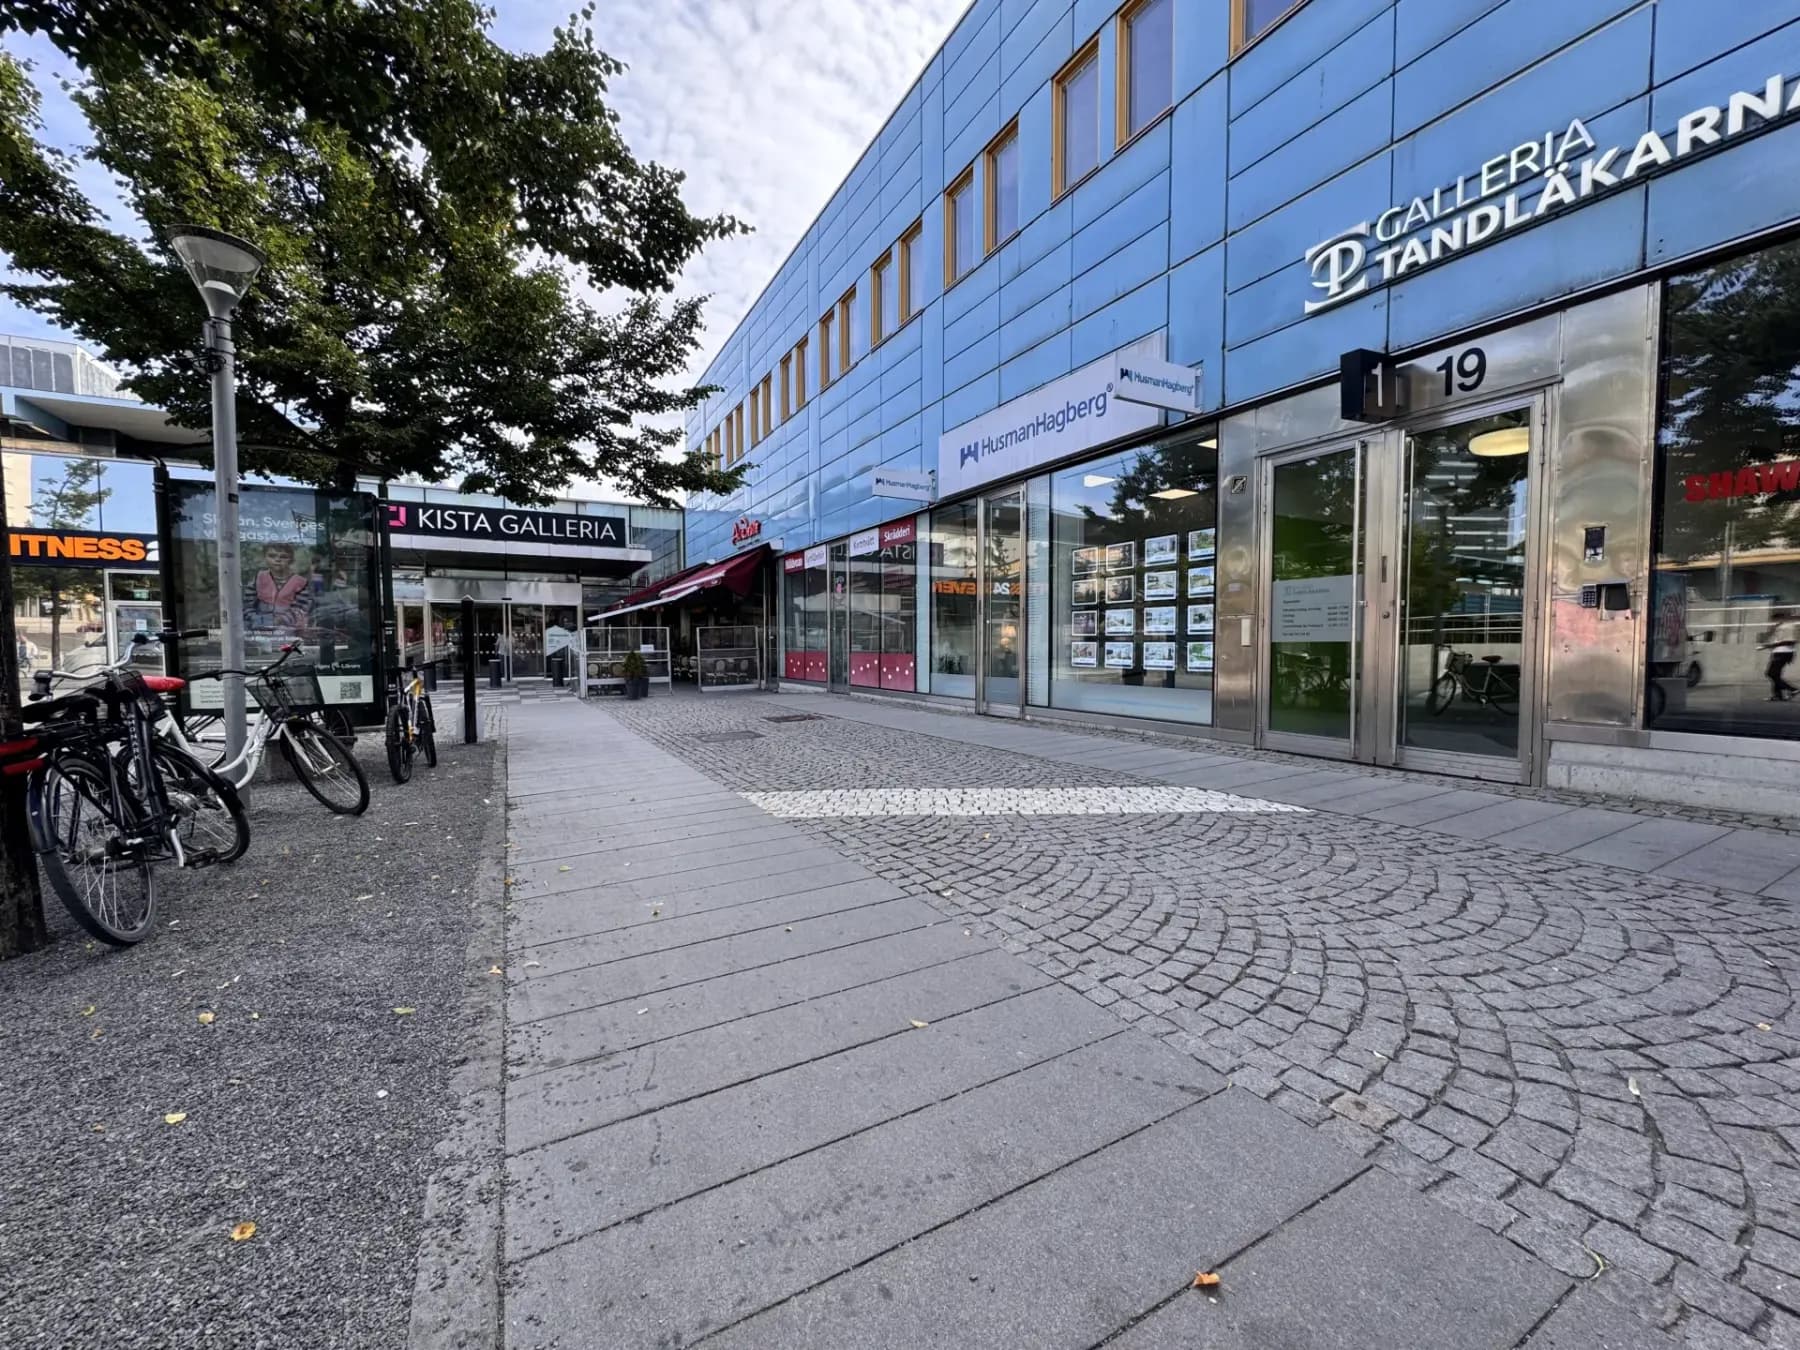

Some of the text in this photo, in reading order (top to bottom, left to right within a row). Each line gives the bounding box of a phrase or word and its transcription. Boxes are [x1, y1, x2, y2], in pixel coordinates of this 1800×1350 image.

[1375, 118, 1596, 243] GALLERIA
[1134, 370, 1194, 396] HusmanHagberg
[1436, 347, 1487, 396] 19
[263, 517, 326, 533] Sveriges
[418, 508, 616, 541] KISTA GALLERIA
